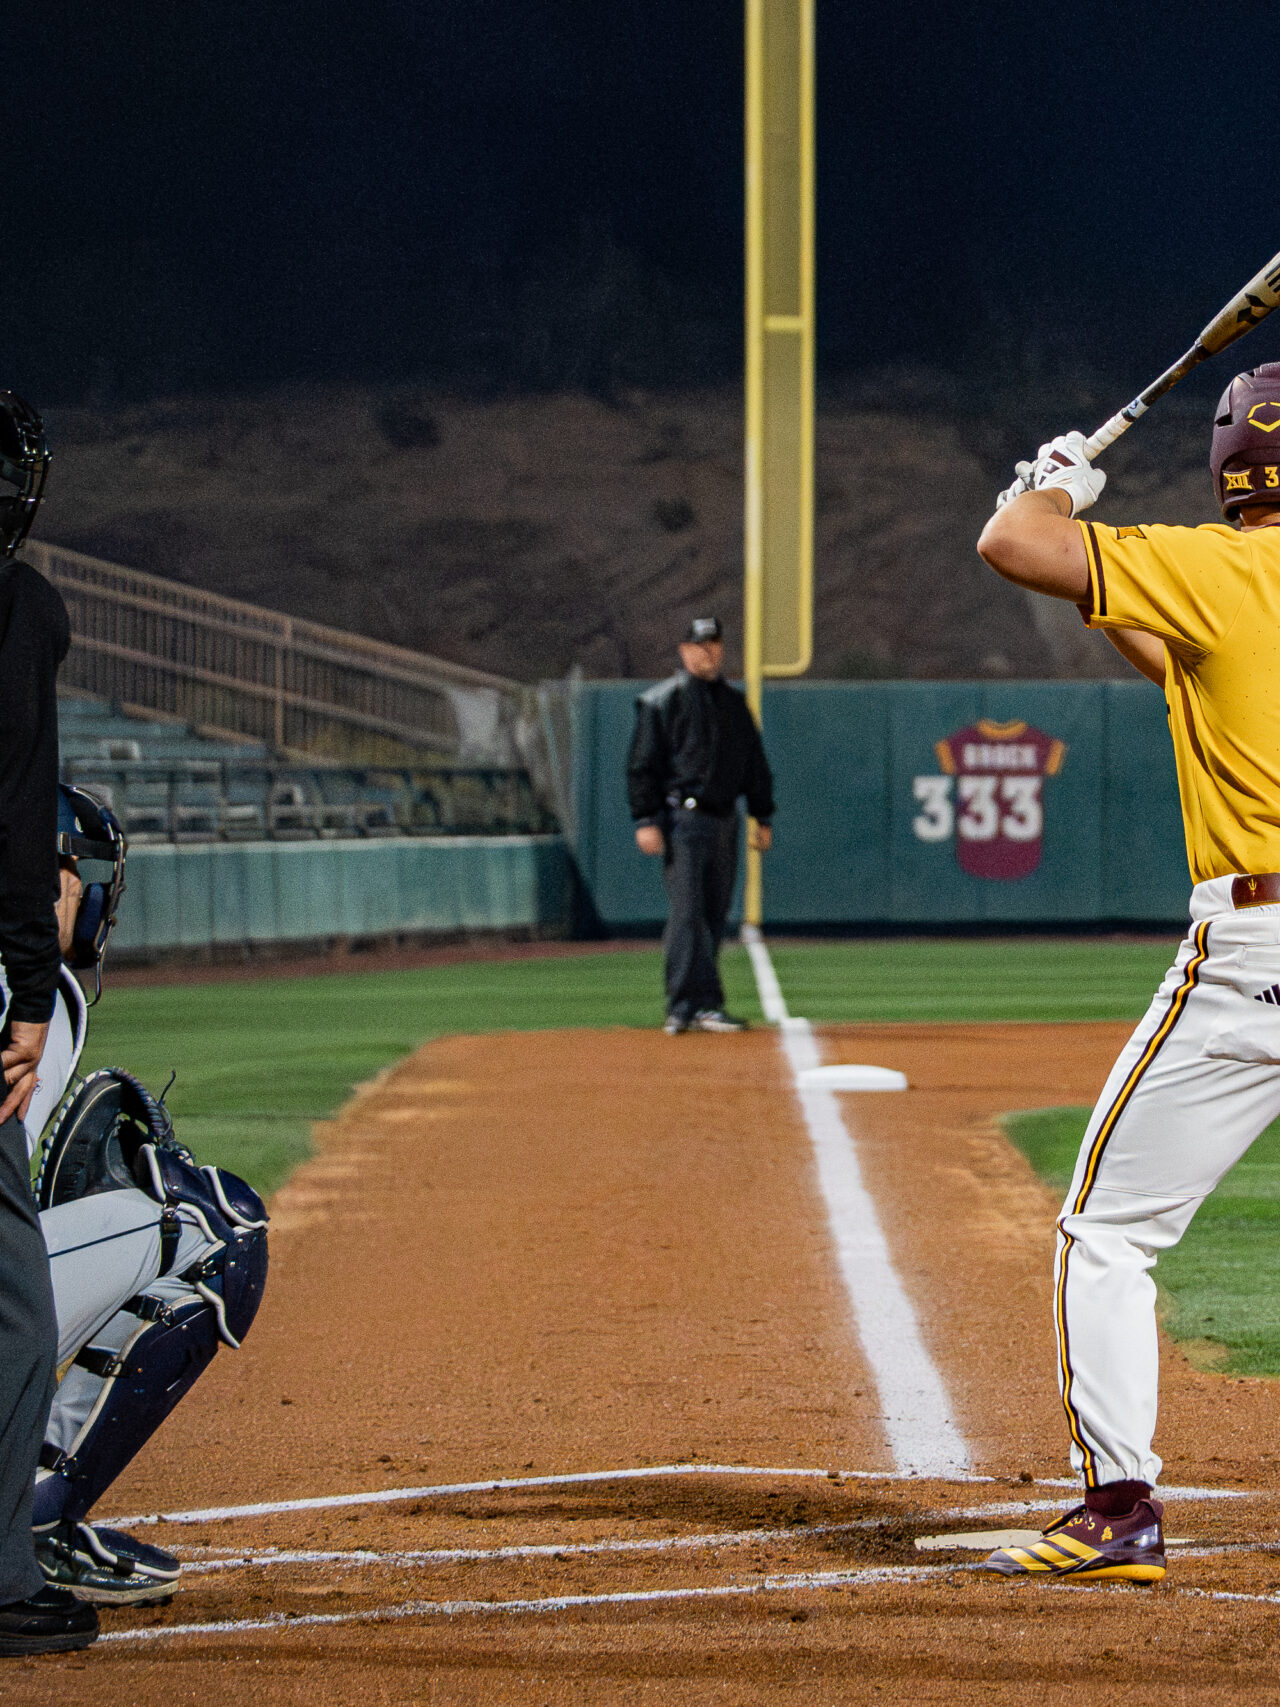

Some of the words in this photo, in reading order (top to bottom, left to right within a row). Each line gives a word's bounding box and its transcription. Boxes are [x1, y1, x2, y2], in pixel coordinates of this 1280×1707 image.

[1223, 470, 1253, 491] XII
[1264, 466, 1280, 488] 3
[912, 774, 1045, 842] 333
